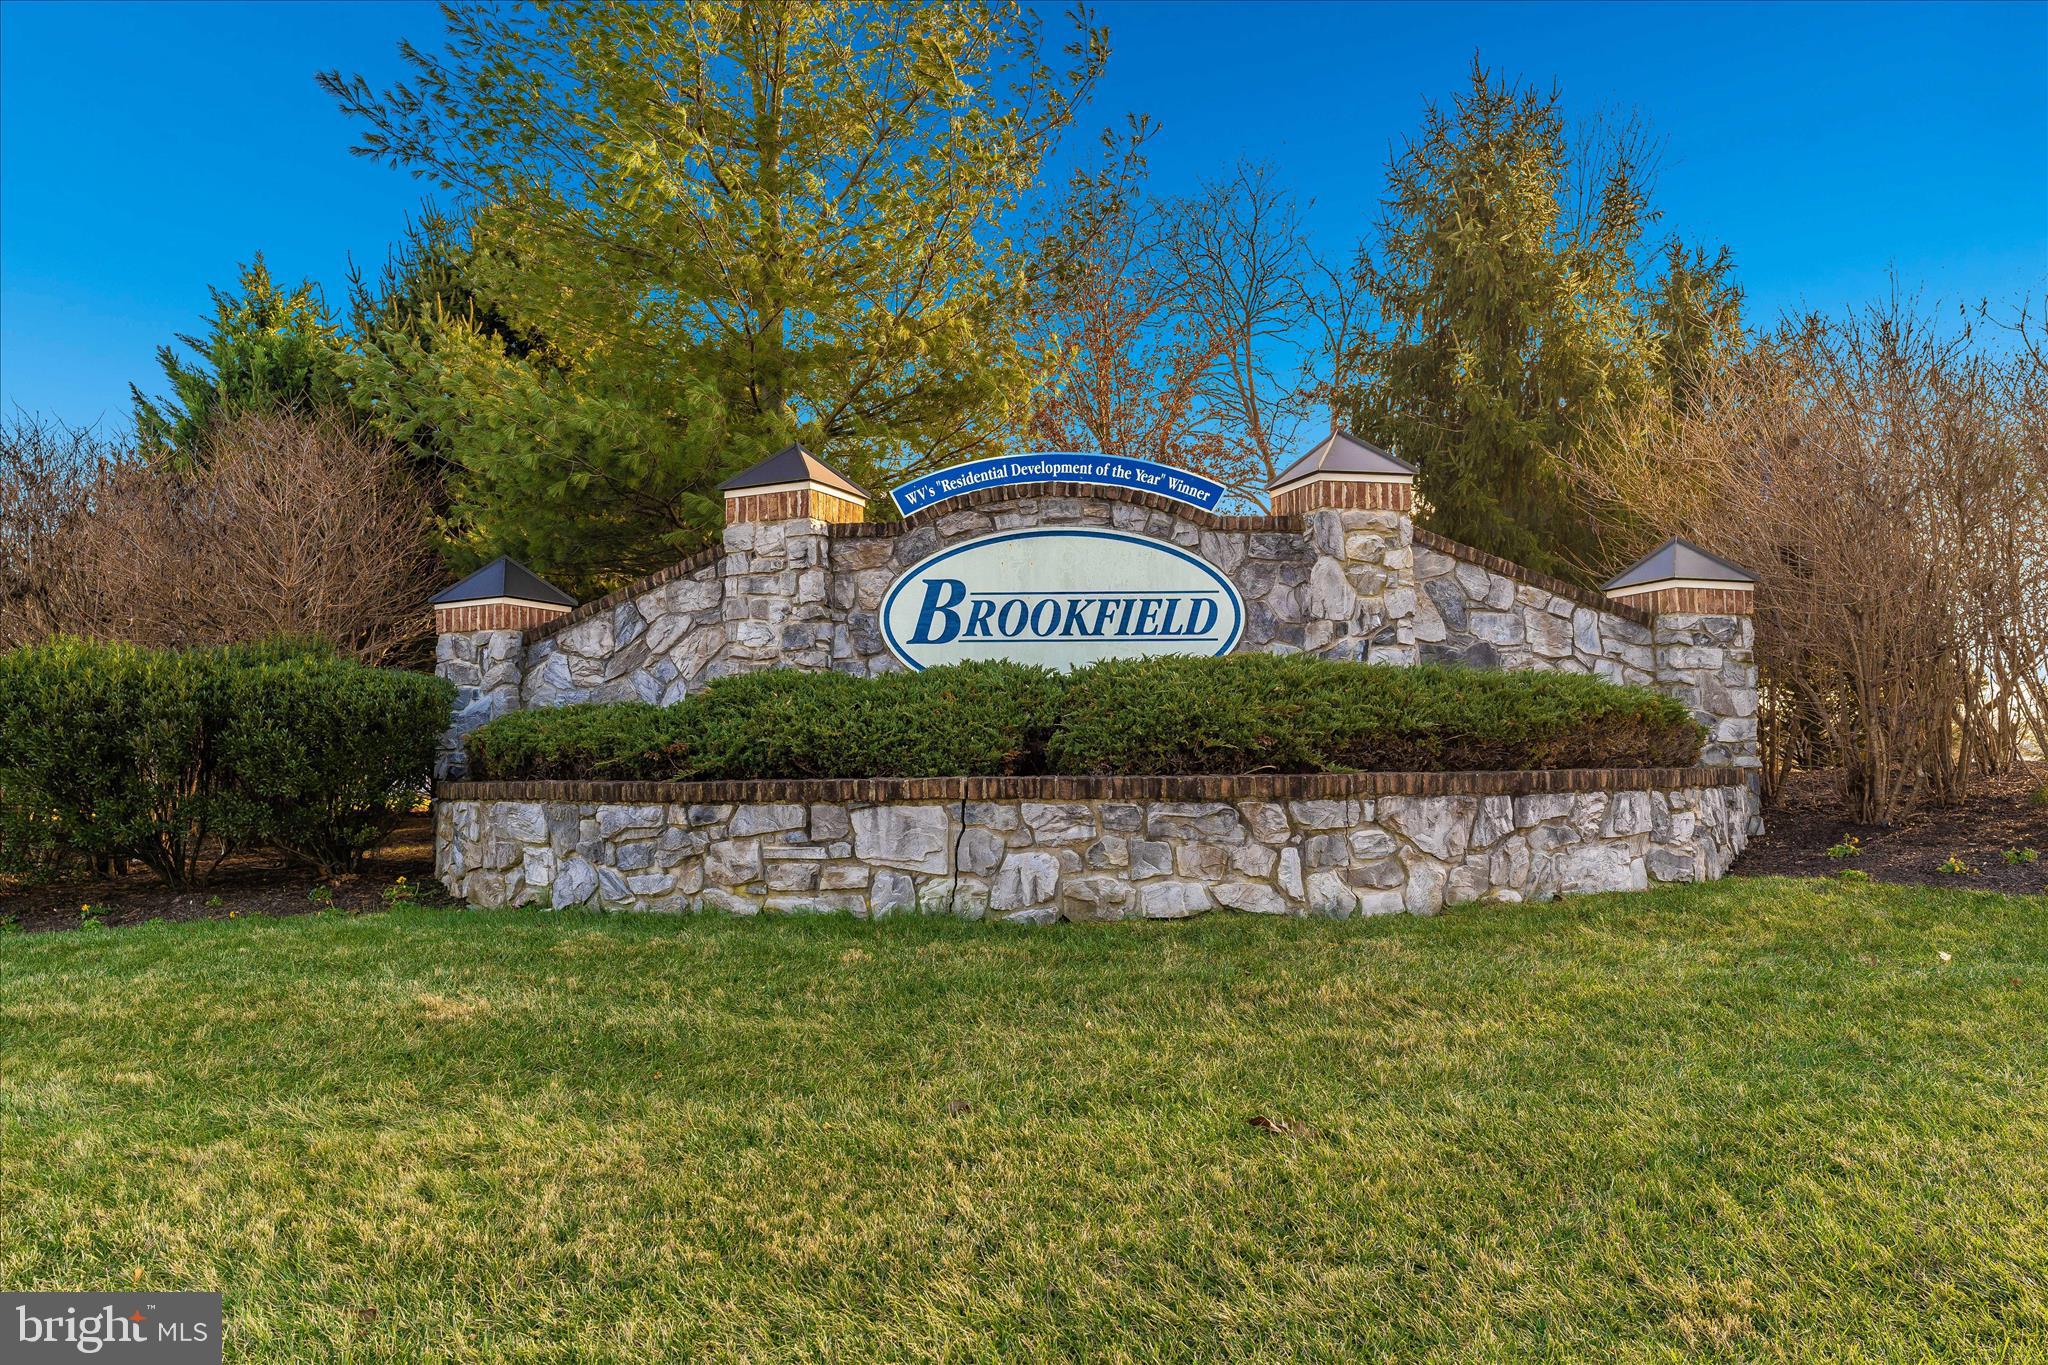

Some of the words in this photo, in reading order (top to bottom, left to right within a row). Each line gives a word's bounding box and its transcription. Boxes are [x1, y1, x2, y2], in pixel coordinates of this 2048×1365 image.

[905, 485, 935, 505] WV's
[936, 465, 1008, 492] "Residential
[1011, 461, 1092, 477] Development
[1096, 463, 1111, 476] of
[1112, 465, 1132, 479] the
[1135, 469, 1166, 485] Year"
[1168, 476, 1211, 501] Winner
[906, 578, 1218, 644] BROOKFIELD
